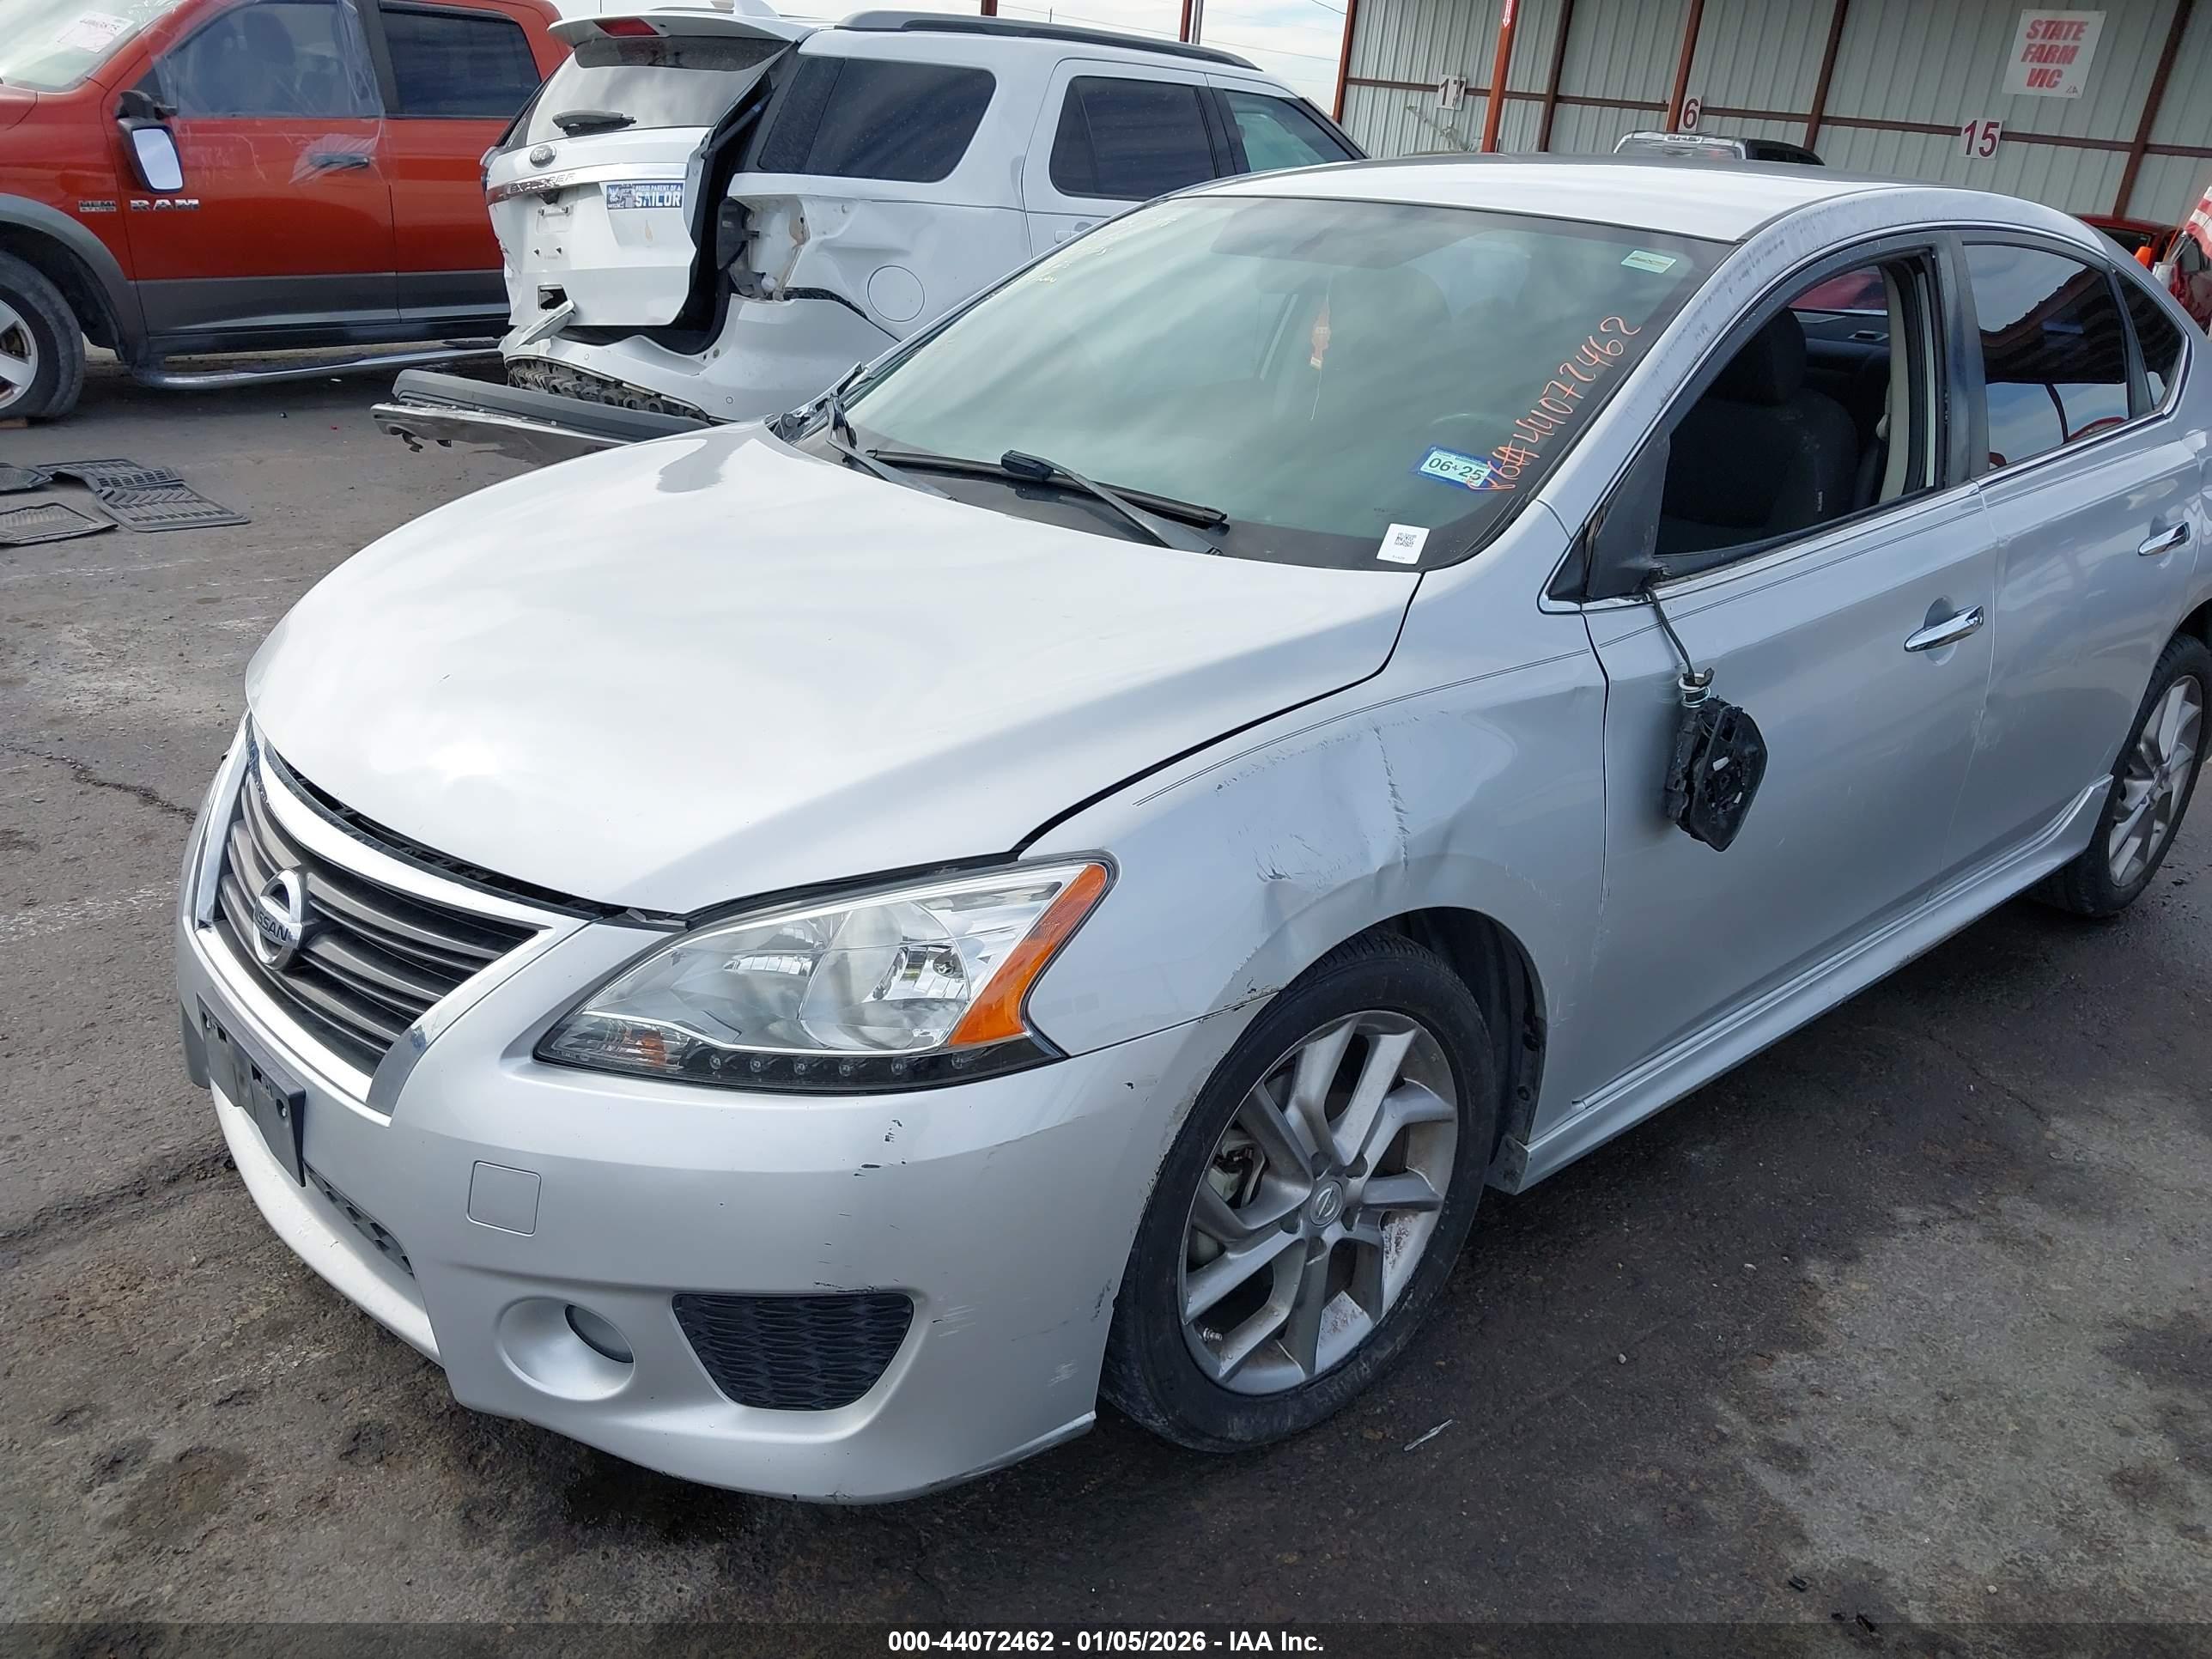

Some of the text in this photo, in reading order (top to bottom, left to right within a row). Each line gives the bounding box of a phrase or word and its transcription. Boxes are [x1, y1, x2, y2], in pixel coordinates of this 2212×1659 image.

[2026, 19, 2088, 41] STATE
[2021, 43, 2080, 65] FARM
[2026, 68, 2063, 88] VIC
[1963, 119, 2000, 157] 15
[130, 198, 199, 211] RAM
[635, 191, 681, 207] SAILOR
[254, 910, 289, 942] ISSAN
